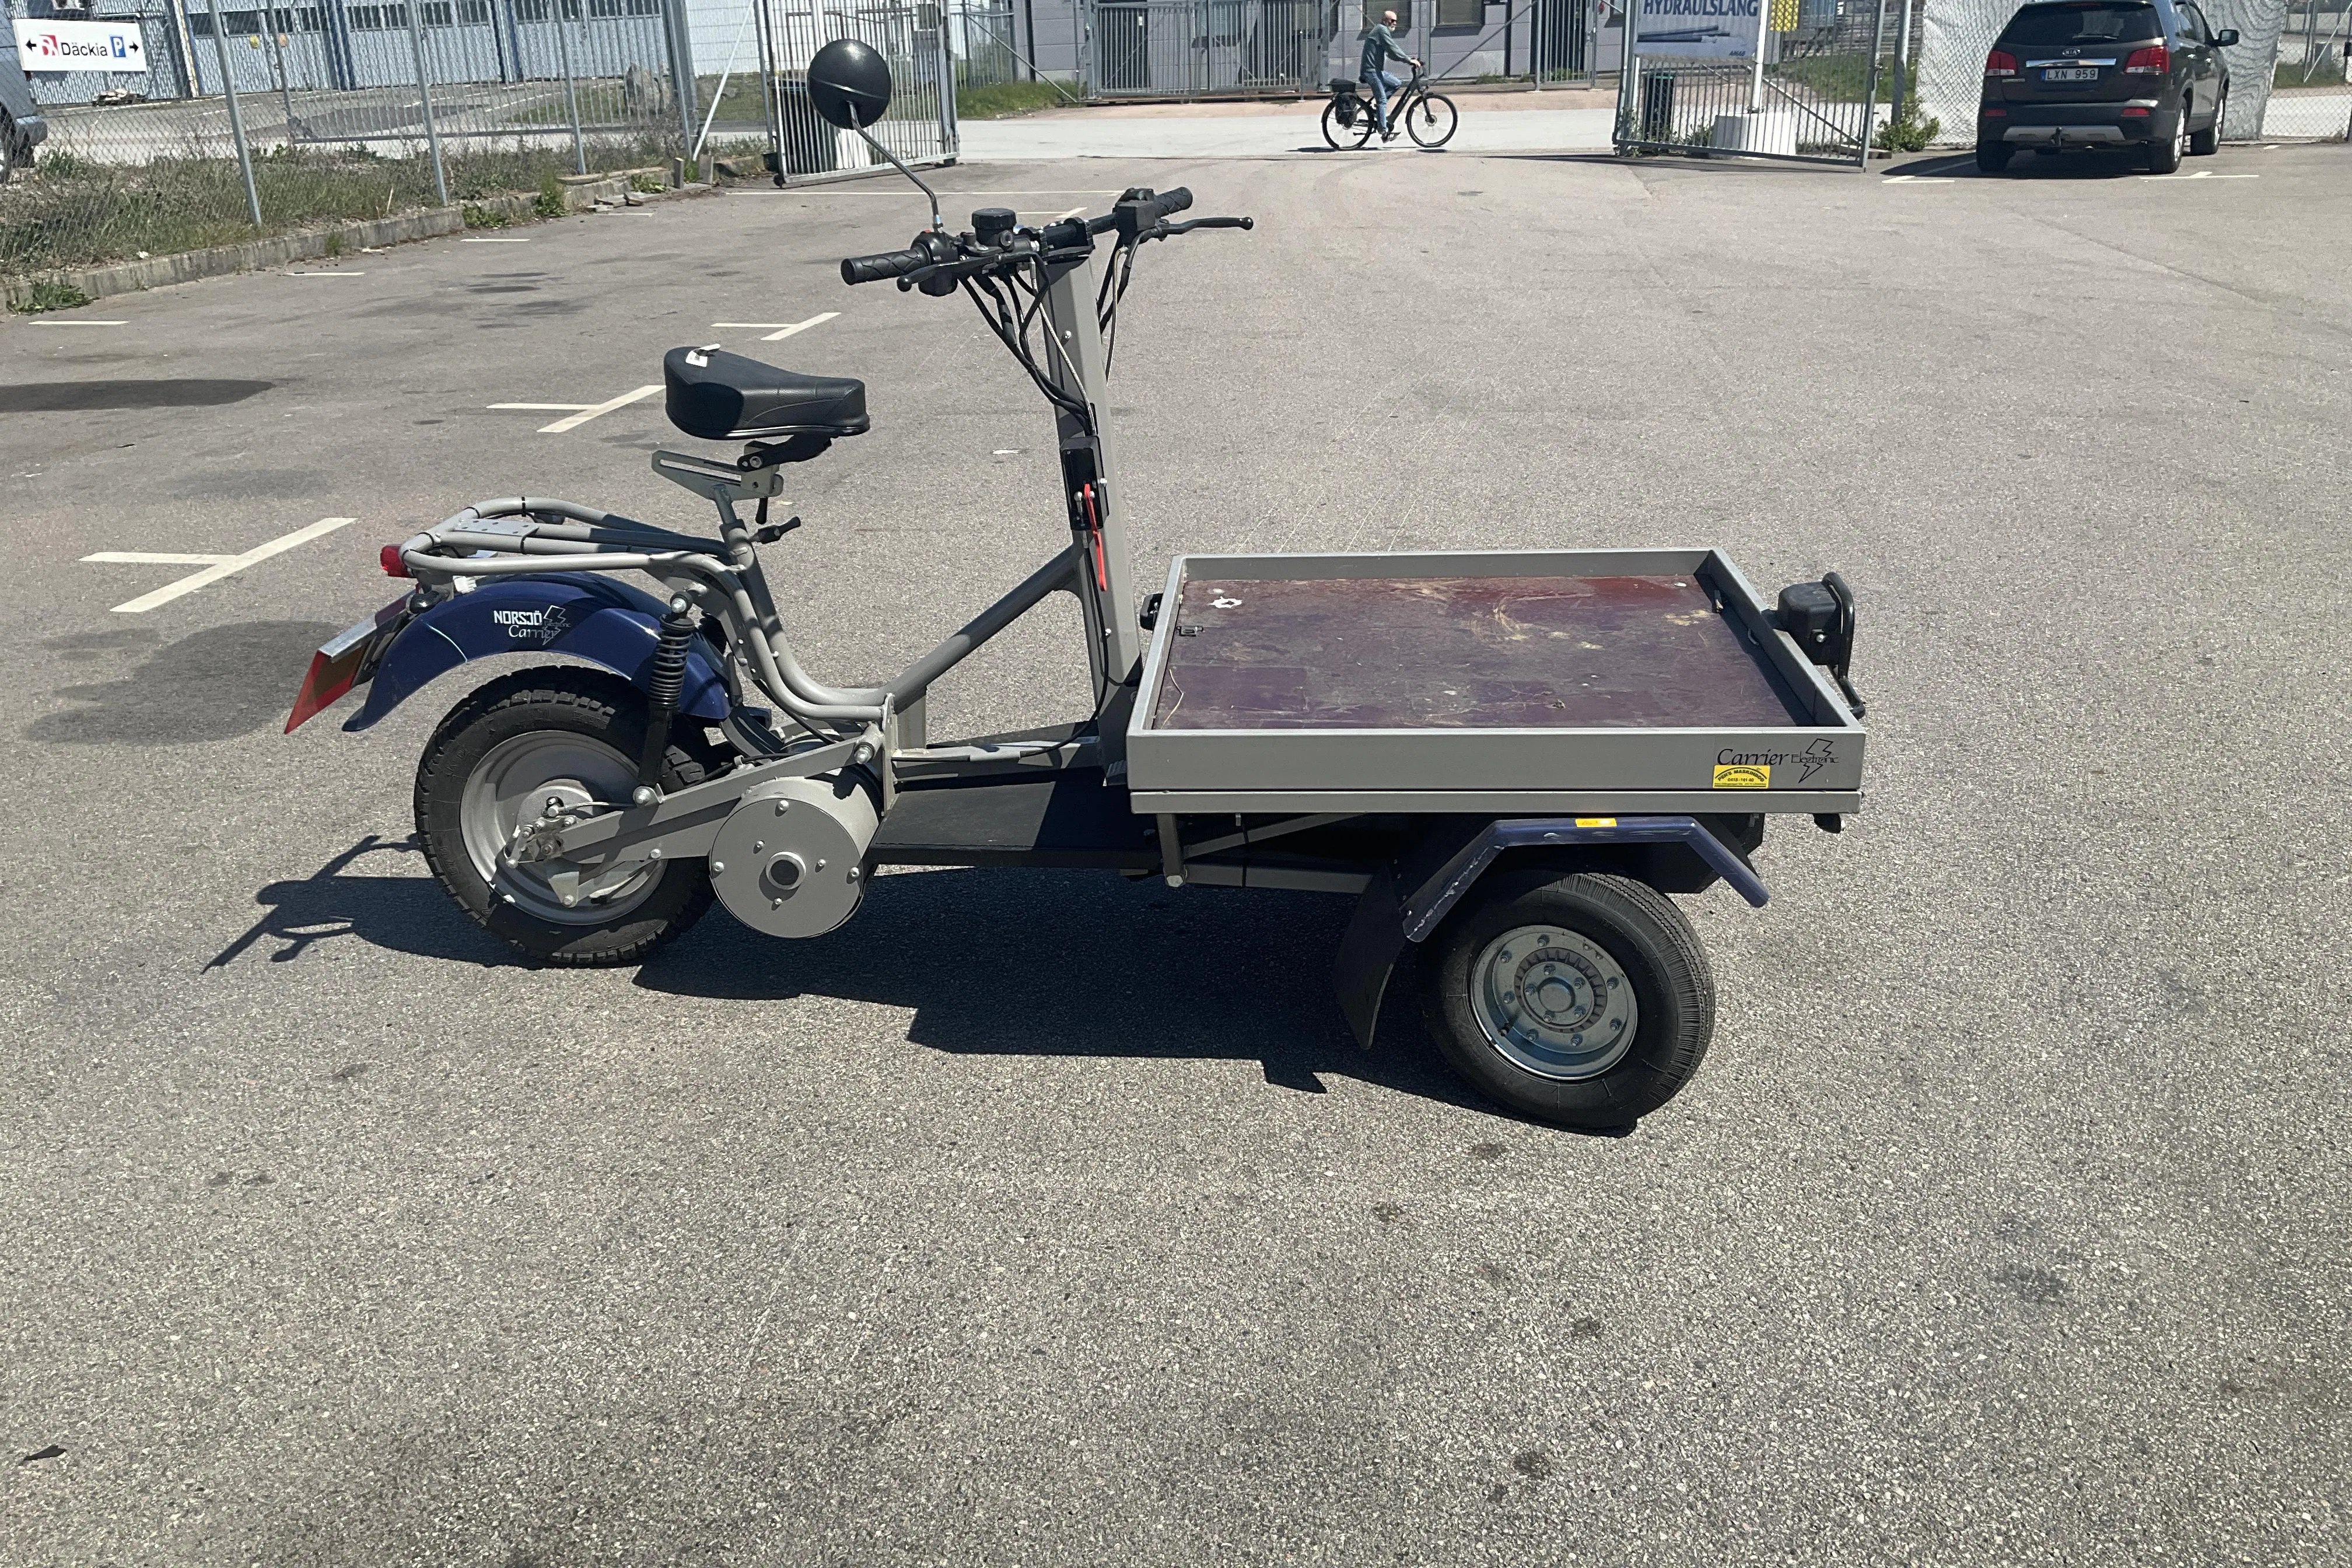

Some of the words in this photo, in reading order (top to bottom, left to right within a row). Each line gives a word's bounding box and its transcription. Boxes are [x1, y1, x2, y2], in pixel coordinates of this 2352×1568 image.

[1643, 0, 1758, 16] HYDRAULSLANG
[61, 42, 108, 56] Däckia
[113, 37, 123, 57] P
[2047, 70, 2067, 79] LXN
[2075, 69, 2096, 79] 959
[493, 610, 542, 625] NORSJÖ
[508, 624, 556, 639] Carrier
[1717, 748, 1789, 765] Carrier
